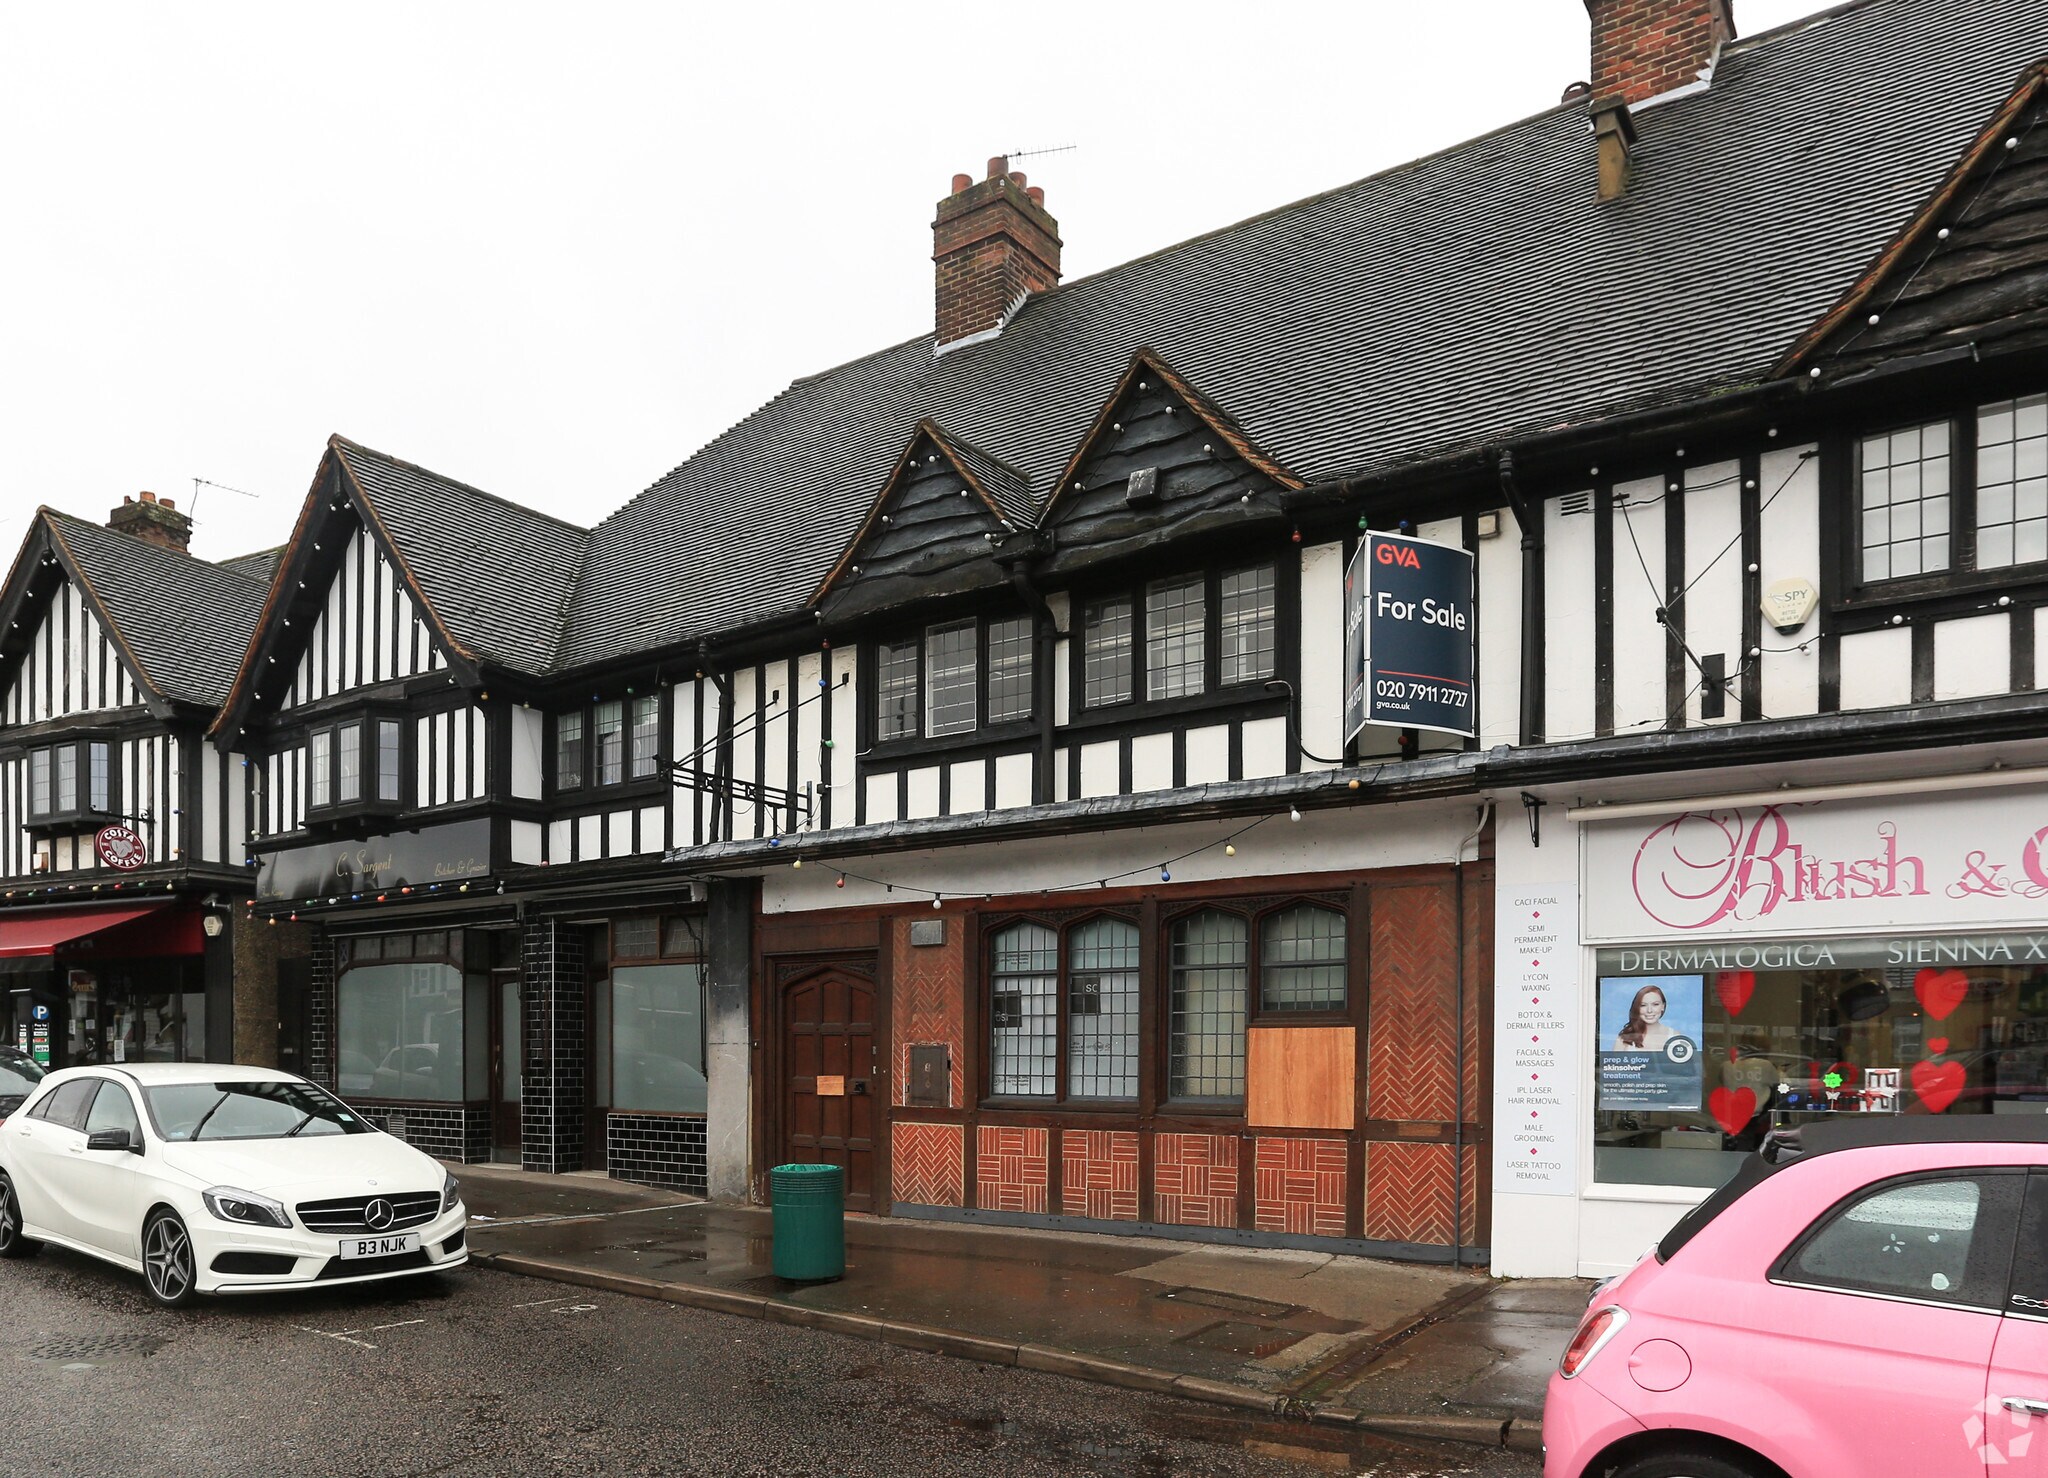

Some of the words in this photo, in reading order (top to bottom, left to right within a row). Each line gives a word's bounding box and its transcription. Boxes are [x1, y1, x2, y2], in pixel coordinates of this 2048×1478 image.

[1376, 543, 1421, 569] GVA
[1784, 589, 1808, 602] SPY
[1377, 591, 1416, 621] For
[1421, 598, 1466, 631] Sale
[1376, 680, 1406, 699] 020
[1409, 683, 1438, 702] 7911
[1440, 687, 1468, 708] 2727
[1376, 700, 1411, 711] gva.co.uk
[104, 829, 134, 842] COSTA
[105, 850, 142, 867] COFFEE
[336, 851, 349, 877] C.
[352, 849, 392, 879] Sargent
[1632, 802, 1930, 929] Blush
[1945, 850, 2009, 899] &
[1514, 898, 1532, 906] CACI
[1533, 897, 1558, 905] FACIAL
[1528, 925, 1545, 933] SEMI
[1514, 935, 1558, 944] PERMANENT
[1519, 946, 1552, 954] MAKE-UP
[1620, 943, 1836, 972] DERMALOGICA
[1887, 937, 2014, 964] SIENNA
[2024, 935, 2047, 960] X
[1523, 973, 1549, 981] LYCON
[1517, 1011, 1545, 1019] BOTOX
[1506, 1022, 1535, 1030] DERMAL
[1537, 1021, 1565, 1029] FILLERS
[1516, 1048, 1546, 1056] FACIALS
[1547, 1048, 1553, 1056] &
[1515, 1059, 1555, 1067] MASSAGES
[1630, 1056, 1650, 1065] glow
[1529, 1086, 1552, 1094] LASER
[1526, 1097, 1561, 1105] REMOVAL
[1513, 1134, 1555, 1142] GROOMING
[1531, 1161, 1561, 1170] TATTOO
[1515, 1172, 1551, 1180] REMOVAL
[357, 1240, 377, 1256] B3
[380, 1236, 406, 1253] NJK
